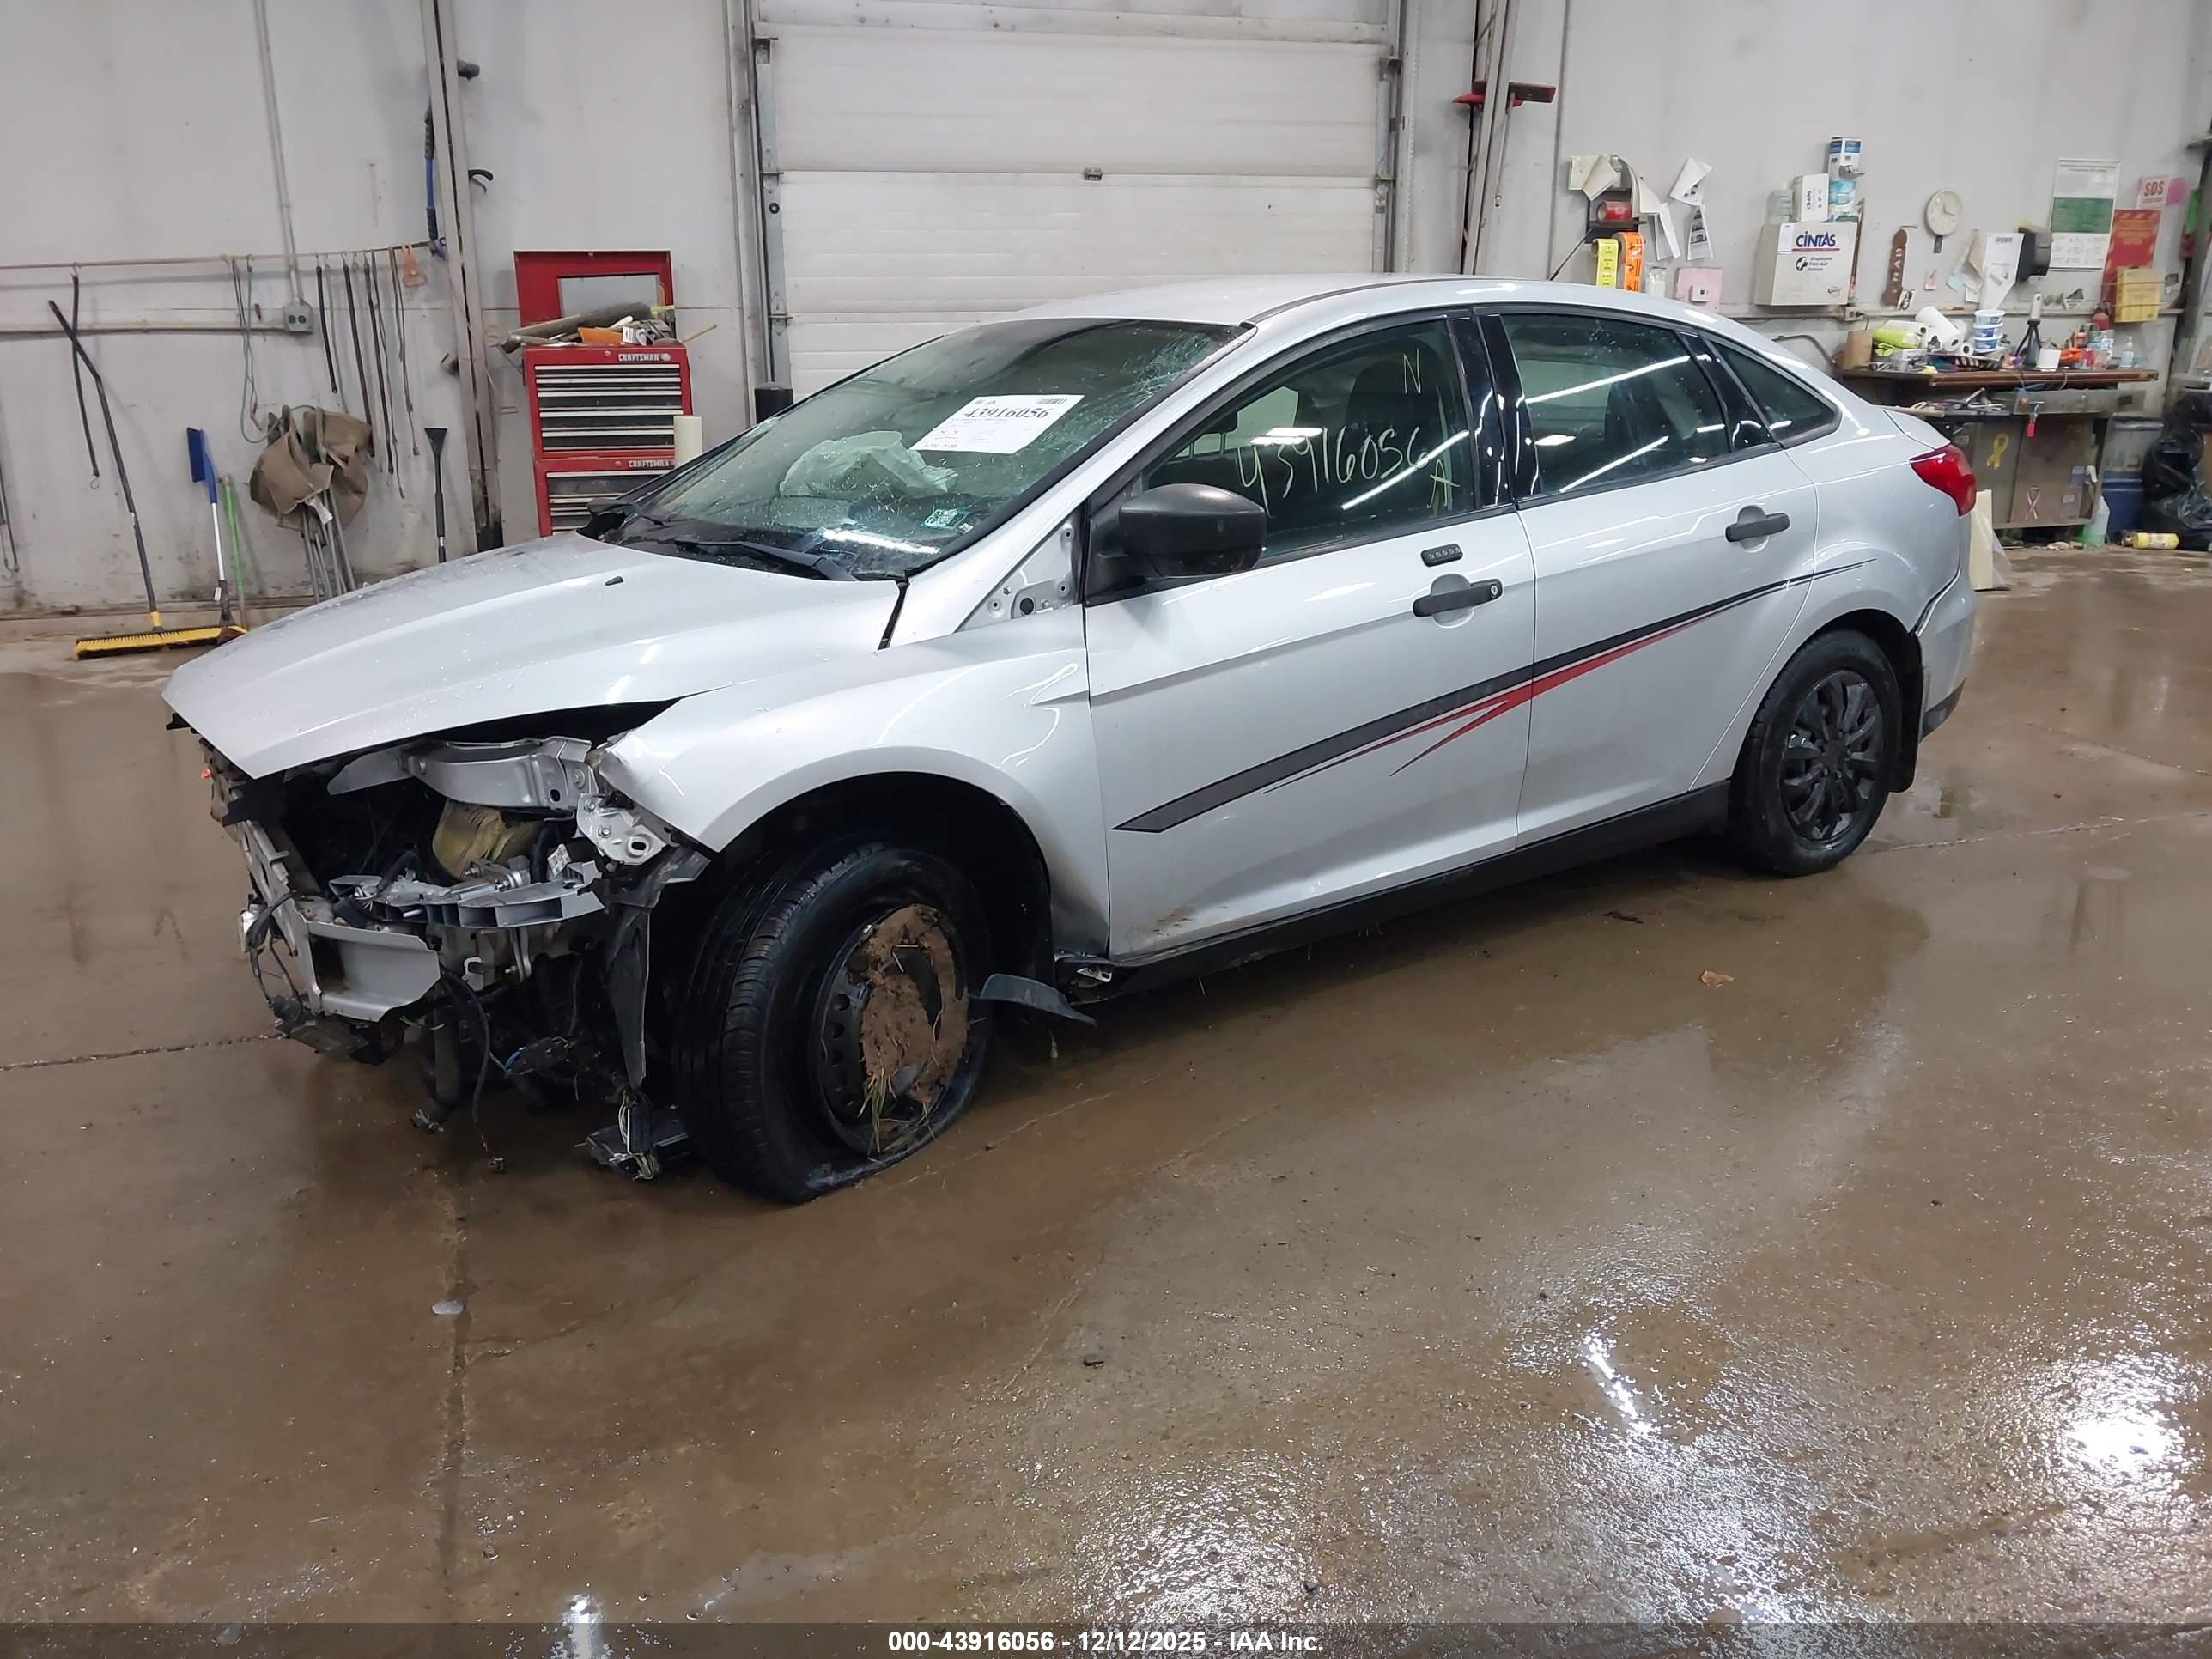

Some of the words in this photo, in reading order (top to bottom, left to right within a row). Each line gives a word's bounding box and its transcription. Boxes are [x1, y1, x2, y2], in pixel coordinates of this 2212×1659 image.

[2144, 180, 2164, 197] SDS
[1796, 229, 1836, 247] CINTAS
[618, 353, 659, 362] CRAFTSMAN
[1403, 348, 1421, 395] N
[964, 407, 1054, 419] 43916056
[628, 459, 670, 468] CRAFTSMAN
